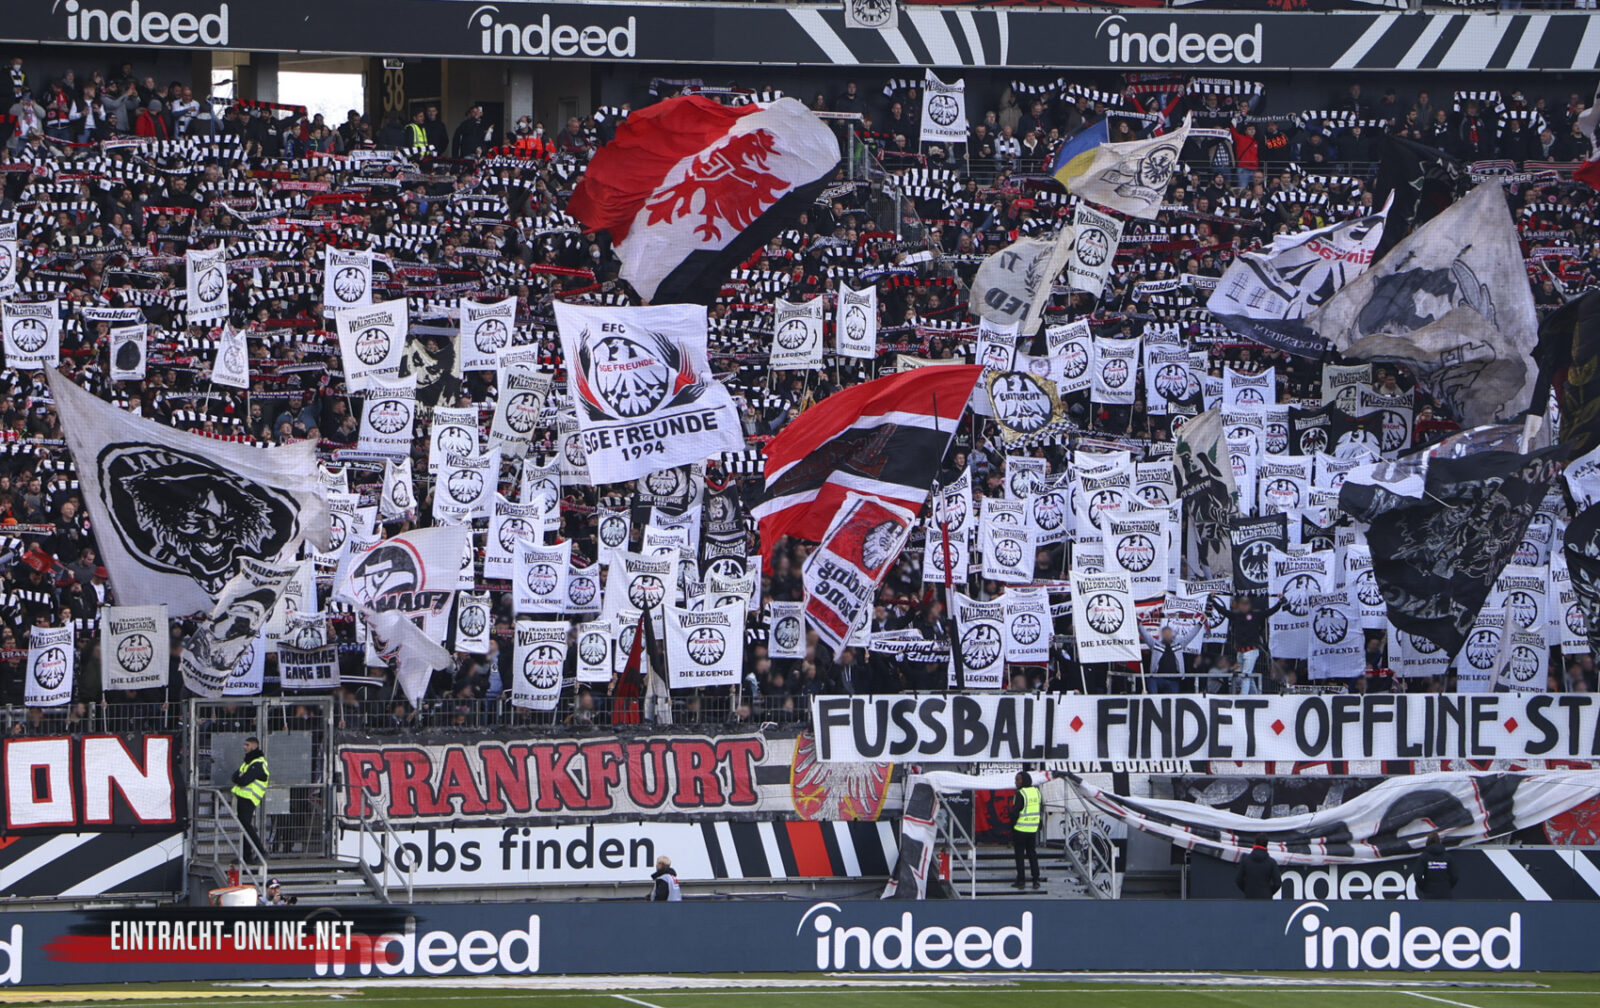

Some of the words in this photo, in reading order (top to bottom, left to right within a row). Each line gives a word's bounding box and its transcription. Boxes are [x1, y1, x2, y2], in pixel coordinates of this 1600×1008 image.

[66, 0, 228, 46] indeed
[480, 14, 636, 58] indeed
[1108, 16, 1262, 64] indeed
[1077, 212, 1119, 242] WALDSTADION
[4, 304, 53, 318] WALDSTADION
[85, 308, 142, 321] Frankfurt
[468, 305, 512, 321] WALDSTADION
[349, 314, 395, 333] WALDSTADION
[602, 323, 626, 333] EFC
[1049, 326, 1088, 347] WALDSTADION
[363, 367, 400, 377] LGENDE
[614, 359, 654, 371] FREUNDE
[1231, 376, 1269, 387] WALDSTADION
[363, 389, 416, 400] WALDSTADION
[1000, 392, 1042, 401] EINTRACHT
[1360, 391, 1414, 408] WALDSTADION
[434, 414, 478, 425] WALDSTADION
[1222, 415, 1264, 429] WALDSTADION
[584, 430, 612, 454] SGE
[615, 412, 718, 447] FREUNDE
[622, 441, 665, 461] 1994
[1009, 461, 1044, 472] WALDSTADION
[1260, 465, 1306, 480] WALDSTADION
[654, 495, 683, 504] FREUNDE
[495, 502, 539, 519] WALDSTADION
[988, 503, 1024, 514] WALDSTADION
[1111, 522, 1161, 536] WALDSTADION
[1230, 525, 1282, 545] WALDSTADION
[524, 552, 563, 564] WALDSTADION
[625, 560, 671, 574] WALDSTADION
[998, 570, 1027, 578] LEGENDE
[1275, 560, 1327, 577] WALDSTADION
[1077, 580, 1128, 595] WALDSTADION
[1186, 581, 1230, 595] WALDSTADION
[1497, 579, 1545, 594] WALDSTADION
[1006, 603, 1045, 615] WALDSTADION
[1164, 599, 1204, 612] WALDSTADION
[679, 614, 731, 628] WALDSTADION
[960, 606, 1004, 624] WALDSTADION
[109, 620, 157, 635] WALDSTADION
[1274, 623, 1289, 631] DIE
[30, 634, 72, 649] WALDSTADION
[518, 631, 565, 646] WALDSTADIO
[875, 642, 935, 652] Frankfurt
[1320, 647, 1360, 655] LEGENDE
[907, 653, 950, 661] Eintra
[127, 675, 160, 684] LEGENDE
[286, 666, 314, 681] GANG
[41, 692, 70, 701] LEGENDE
[818, 695, 1070, 760] FUSSBALL
[1097, 696, 1269, 759] FINDET
[1294, 694, 1500, 758] OFFLINE
[1524, 693, 1600, 757] ST
[3, 735, 176, 829] ON
[342, 737, 764, 819] FRANKFURT
[368, 826, 482, 874] Jobs
[501, 826, 655, 870] finden
[815, 911, 1032, 970] indeed
[1305, 911, 1521, 971] indeed
